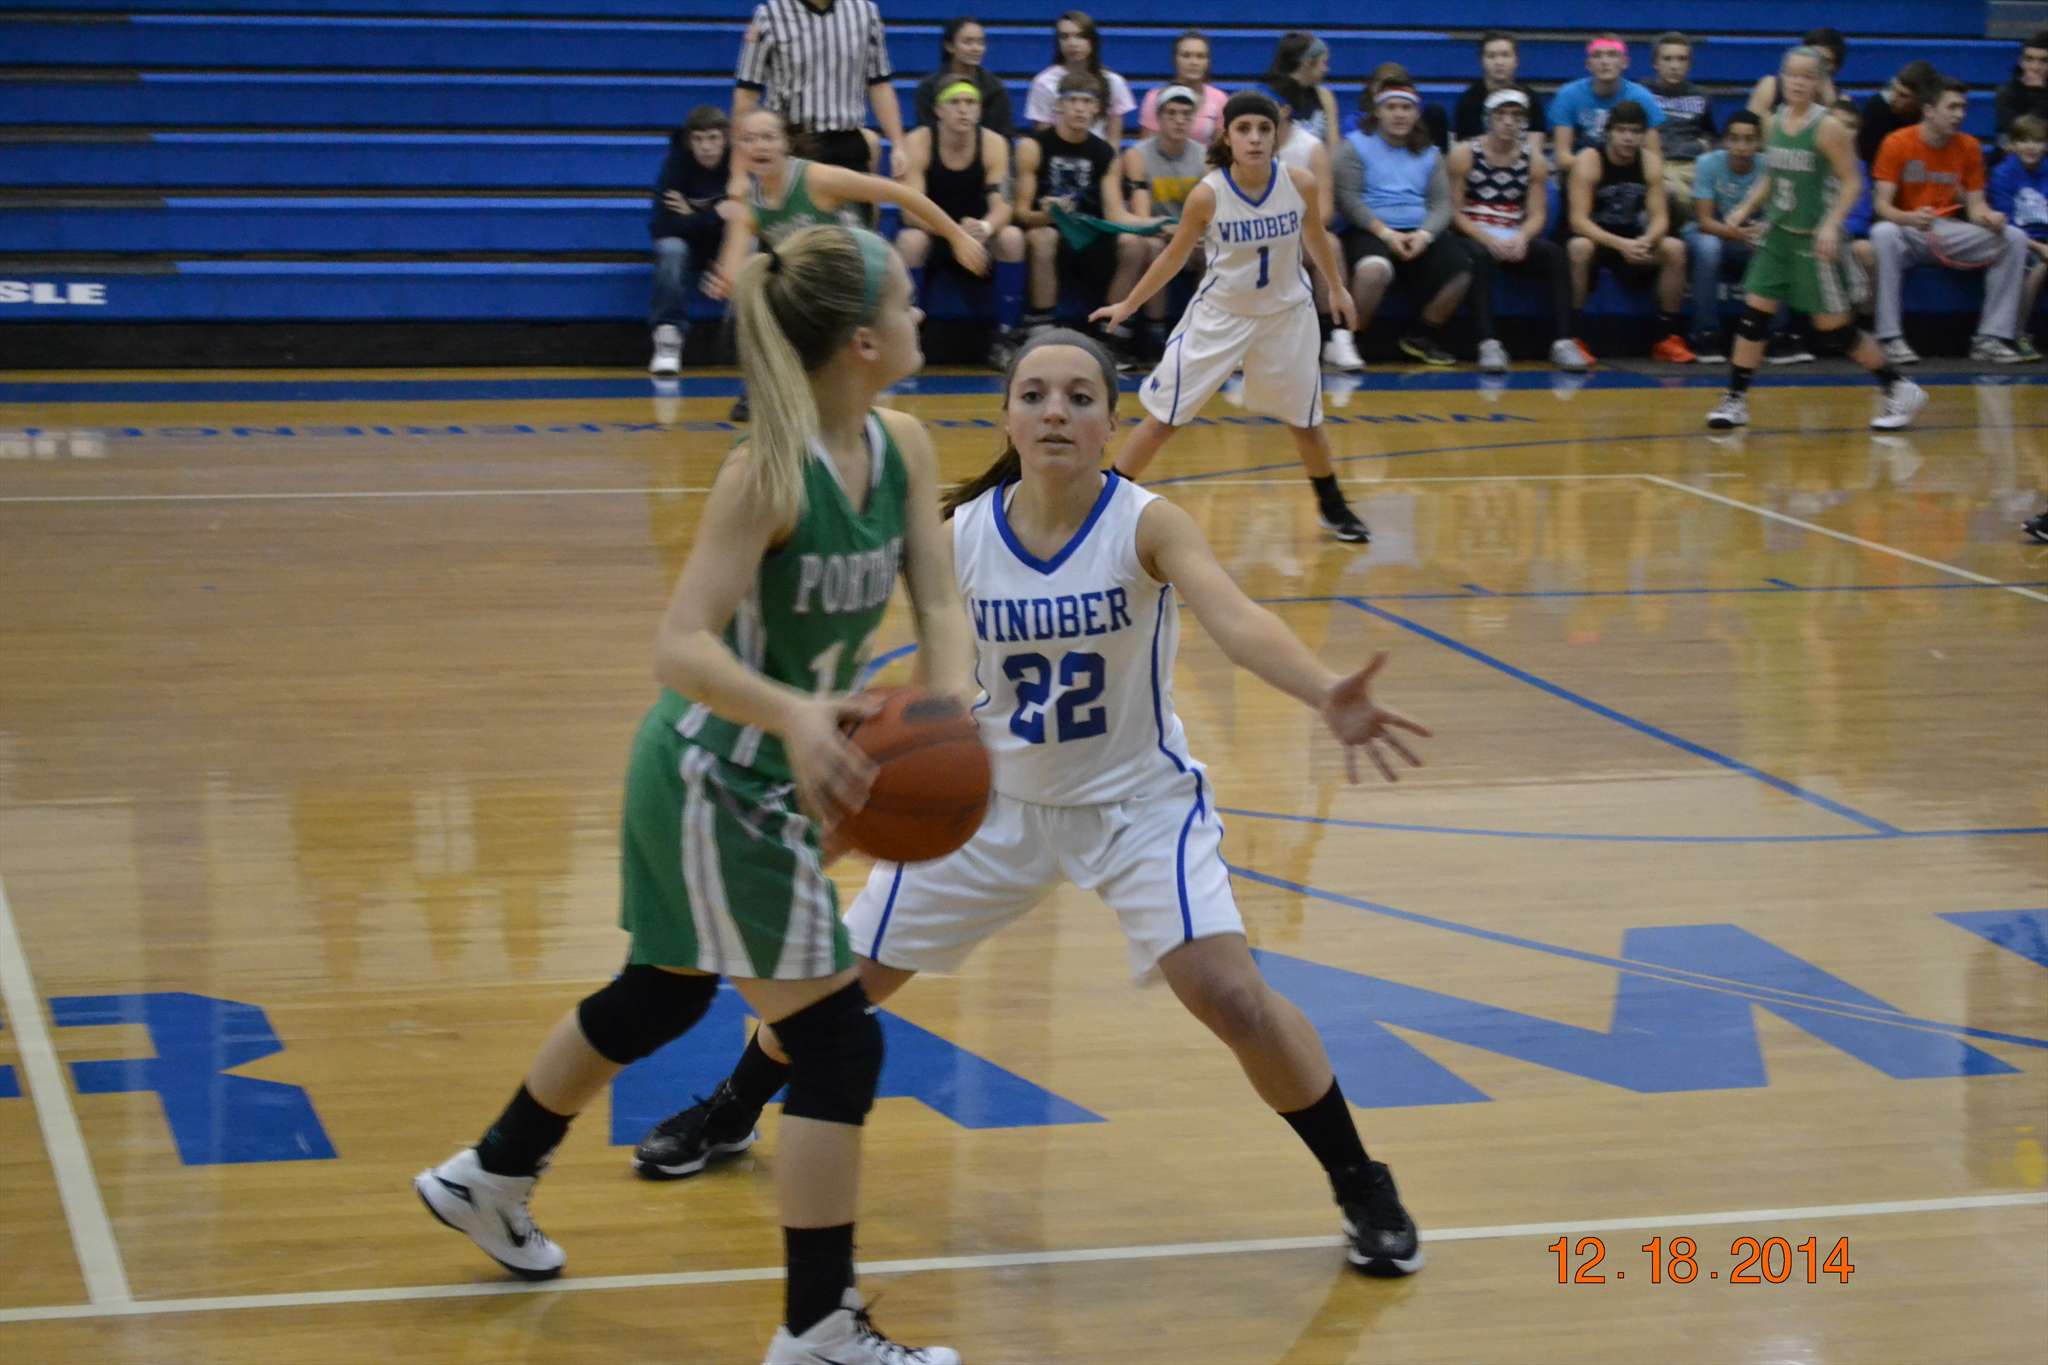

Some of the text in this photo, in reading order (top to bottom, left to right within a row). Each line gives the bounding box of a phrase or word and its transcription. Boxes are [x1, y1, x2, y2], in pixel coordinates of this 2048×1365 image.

[1217, 210, 1299, 243] WINDBER
[1256, 246, 1270, 289] 1
[0, 281, 107, 305] SLE
[971, 586, 1132, 642] WINDBER
[1002, 651, 1107, 744] 22
